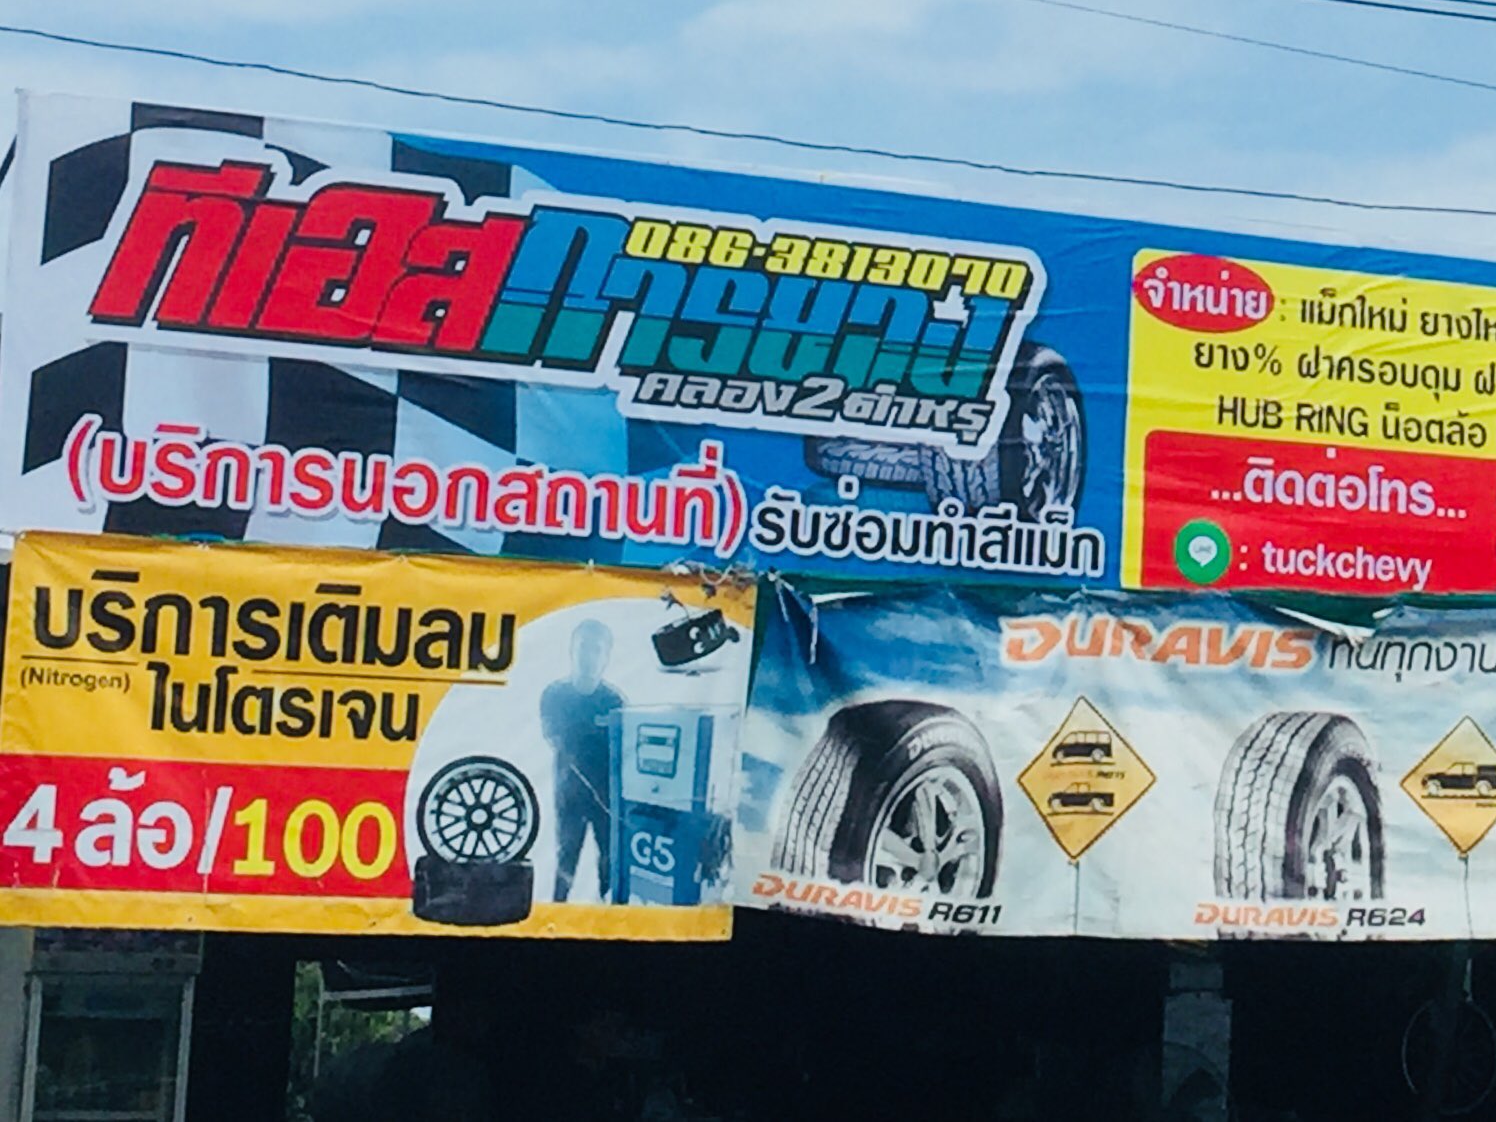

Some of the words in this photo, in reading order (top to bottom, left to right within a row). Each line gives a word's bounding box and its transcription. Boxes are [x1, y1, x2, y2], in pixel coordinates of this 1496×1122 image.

[626, 221, 1028, 301] 086-3813070
[1143, 266, 1267, 320] จำหน่าย
[1300, 287, 1408, 333] แม็กใหม่
[1298, 344, 1462, 403] ฝาครอบดุม
[1217, 395, 1284, 430] HUB
[1295, 403, 1370, 438] RING
[1382, 402, 1488, 448] น็อตล้อ
[66, 418, 744, 554] (บริการนอกสถานที่)
[754, 480, 1101, 572] รับซ่อมทำสีแม็ก
[1261, 540, 1433, 592] tuckchevy
[33, 568, 517, 674] บริการเติมลม
[1005, 618, 1315, 669] DURAVIS
[20, 666, 132, 695] (Nitrogen)
[147, 661, 421, 743] ไนโตรเจน
[630, 831, 676, 873] G5
[753, 874, 923, 918] DURAVIS
[927, 901, 1003, 926] R611
[1194, 902, 1339, 926] DURAVIS
[1346, 906, 1426, 928] R624
